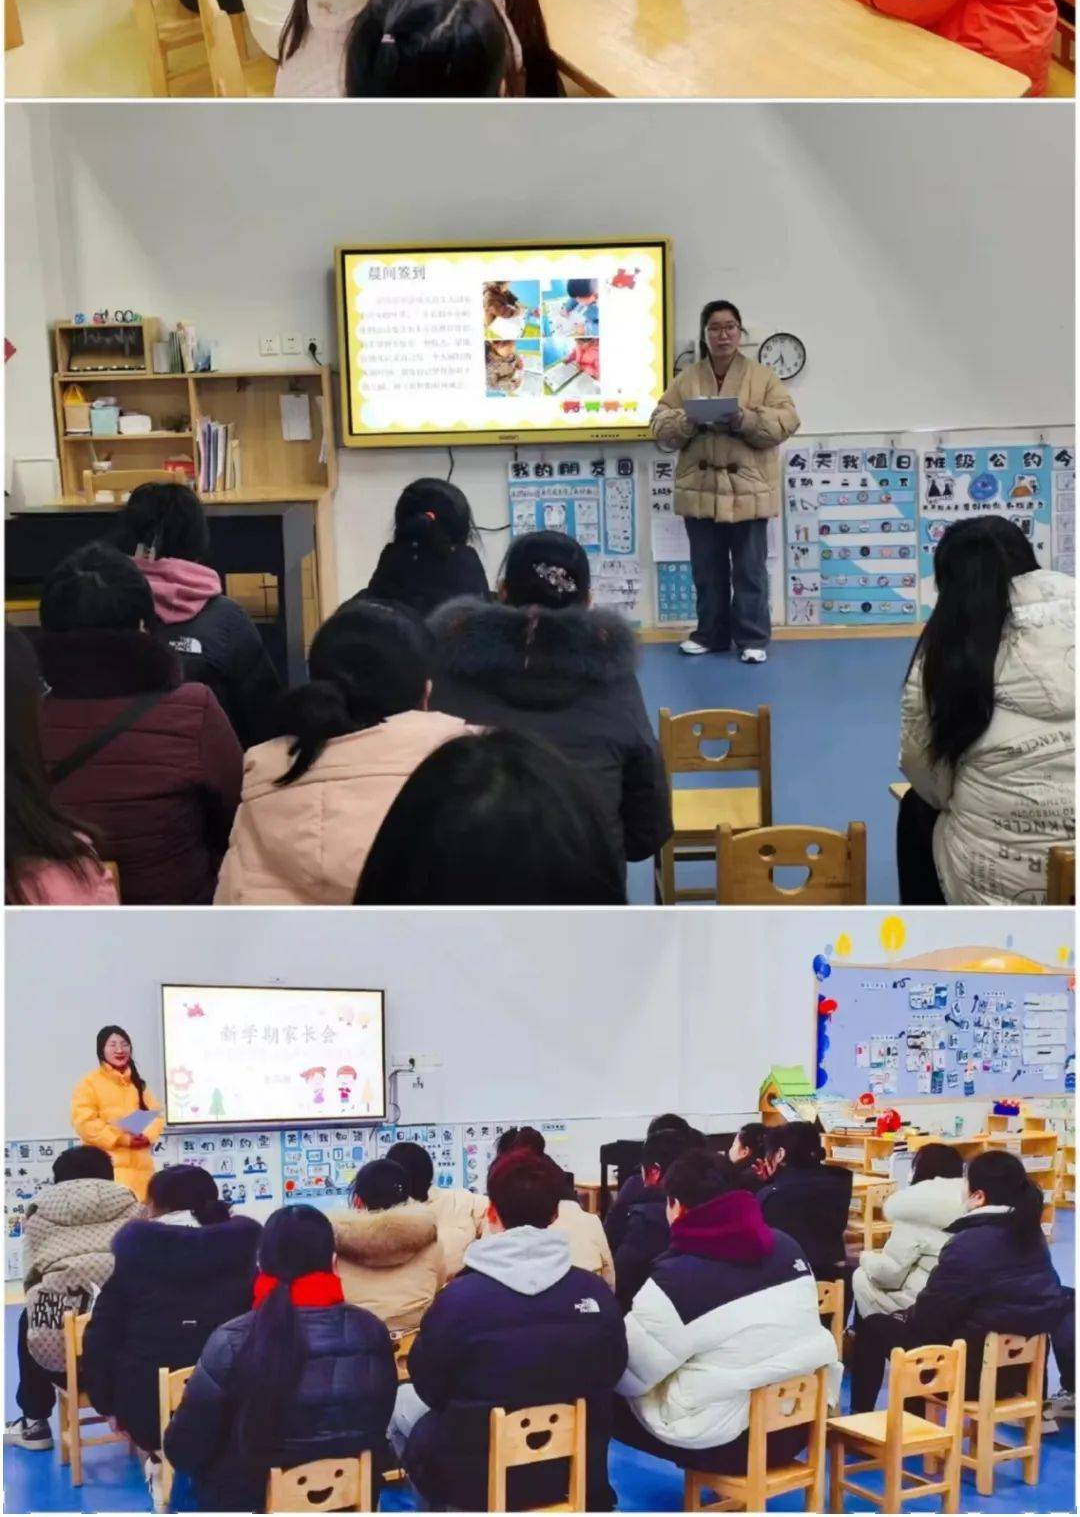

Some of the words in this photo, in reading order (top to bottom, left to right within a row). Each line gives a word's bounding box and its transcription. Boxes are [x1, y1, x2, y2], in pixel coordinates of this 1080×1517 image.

[368, 265, 426, 281] 晨间签到
[511, 458, 635, 478] 我的朋友圈
[788, 452, 912, 471] 今天我值日
[924, 451, 1042, 470] 班级公约
[219, 1024, 337, 1045] 新学期家长会
[31, 1312, 65, 1330] HAN
